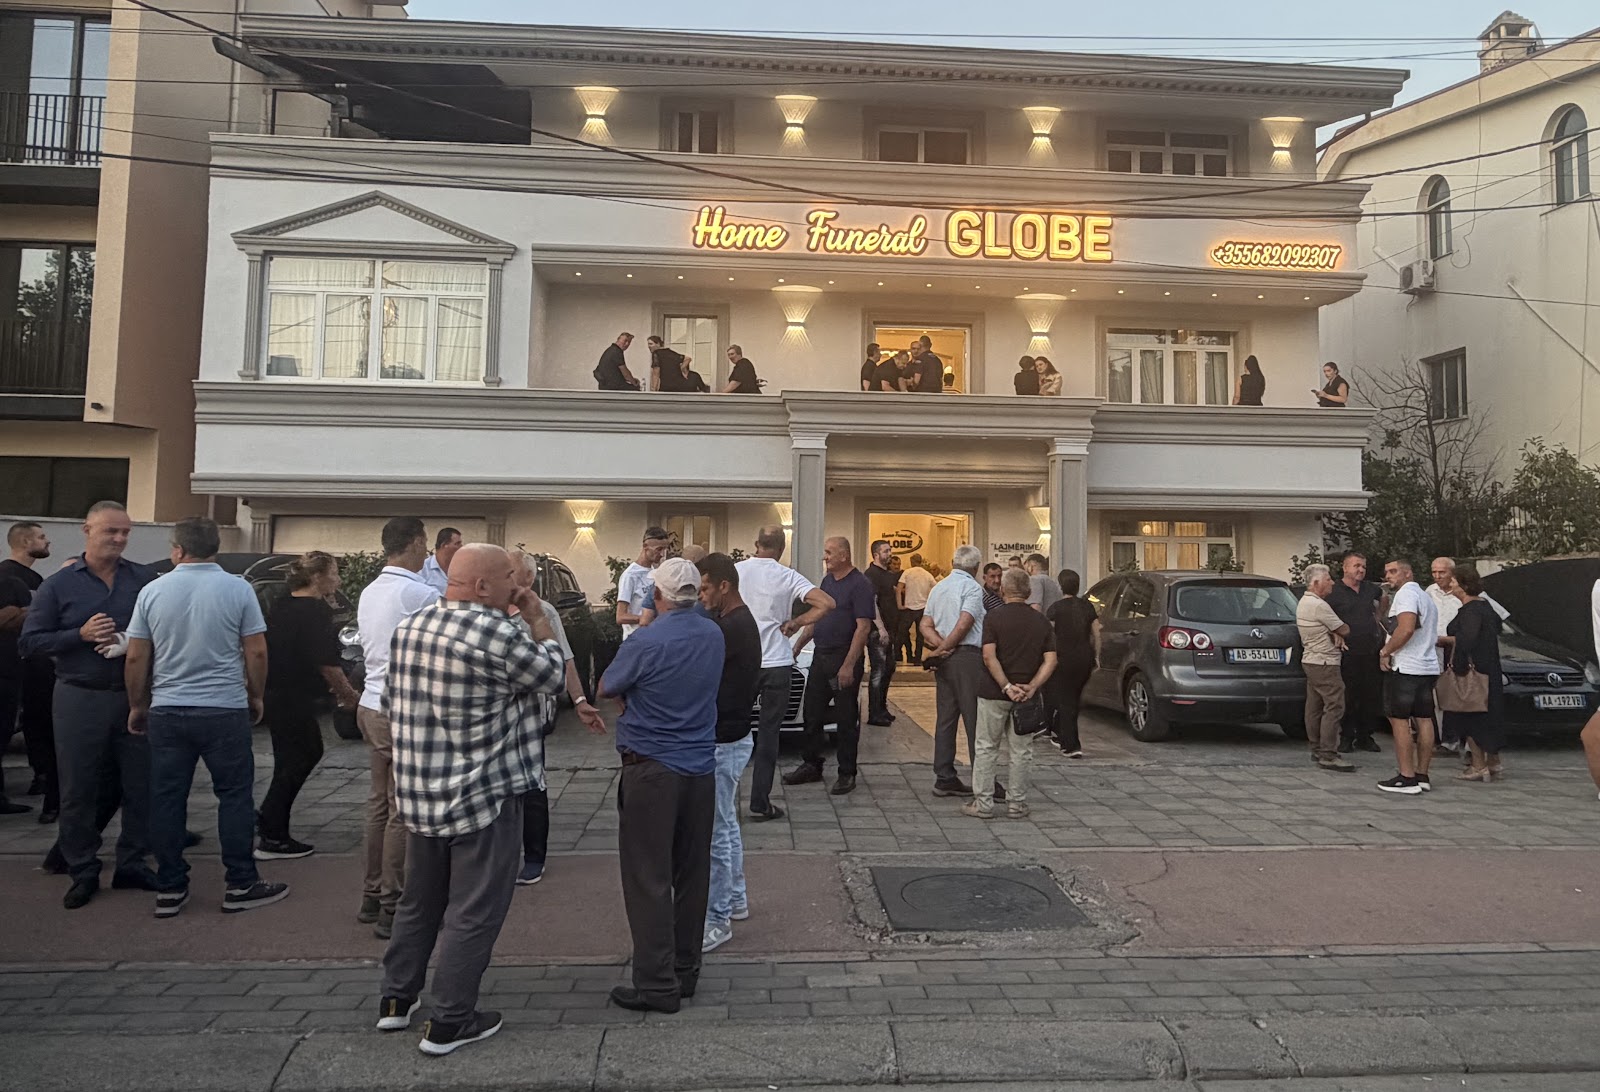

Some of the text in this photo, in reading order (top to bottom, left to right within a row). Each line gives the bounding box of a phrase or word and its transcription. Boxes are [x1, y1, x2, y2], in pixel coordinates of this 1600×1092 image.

[693, 205, 1113, 262] Home Funeral GLOBE
[1213, 241, 1341, 268] +355682092307
